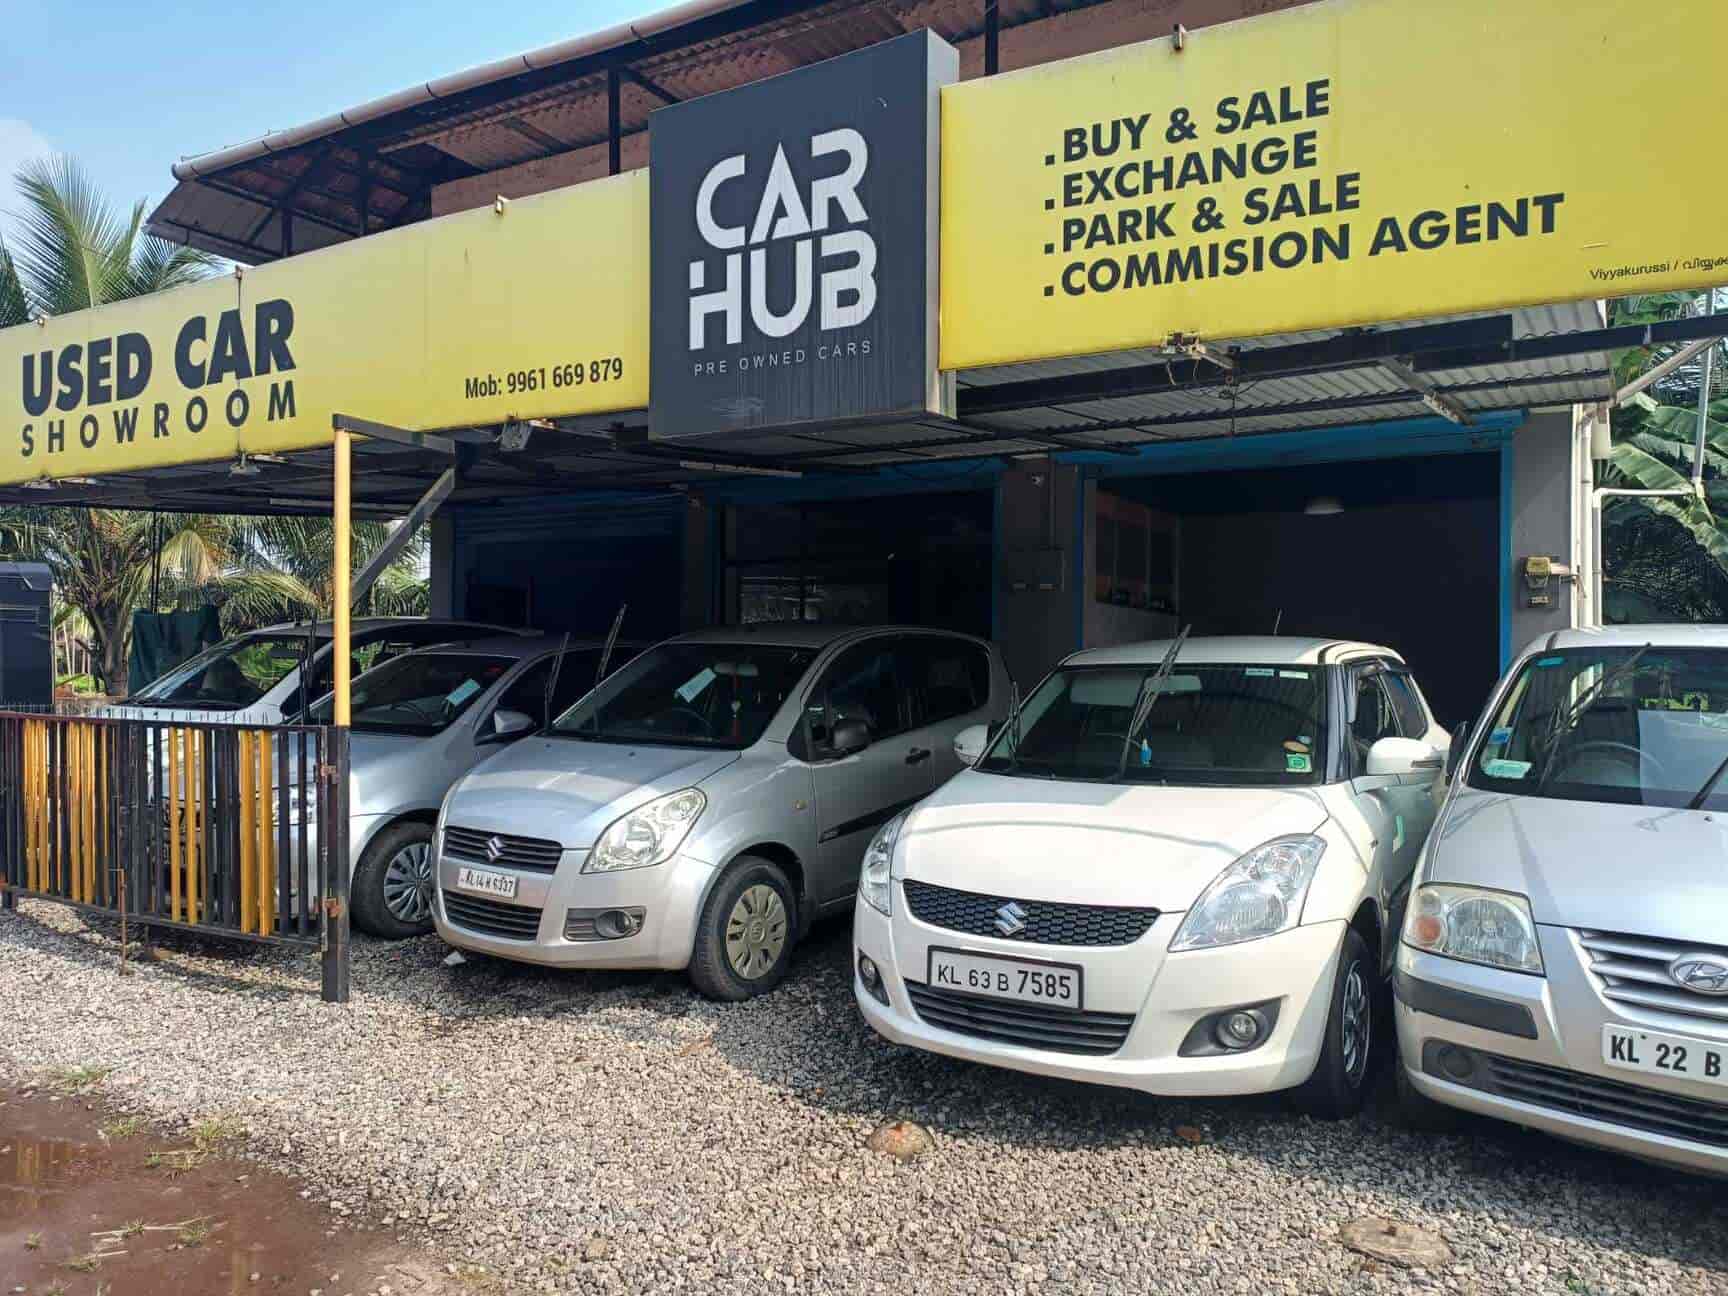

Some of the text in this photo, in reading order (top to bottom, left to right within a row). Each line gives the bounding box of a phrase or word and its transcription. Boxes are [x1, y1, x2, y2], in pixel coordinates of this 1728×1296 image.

[1165, 107, 1198, 144] &
[1215, 78, 1330, 135] SALE
[695, 127, 869, 250] CAR
[1191, 196, 1226, 233] &
[1242, 172, 1361, 226] SALE
[1368, 193, 1566, 258] AGENT
[688, 229, 878, 351] HUB
[1589, 262, 1671, 281] Viyyakurussi
[22, 298, 297, 417] USED CAR
[465, 357, 623, 399] Mob: 9961 669 879
[694, 339, 872, 377] PRE OWNED CARS
[21, 380, 297, 457] SHOWROOM
[938, 964, 1071, 999] KL 63 B 7585
[1611, 1034, 1721, 1077] KL 22 B
